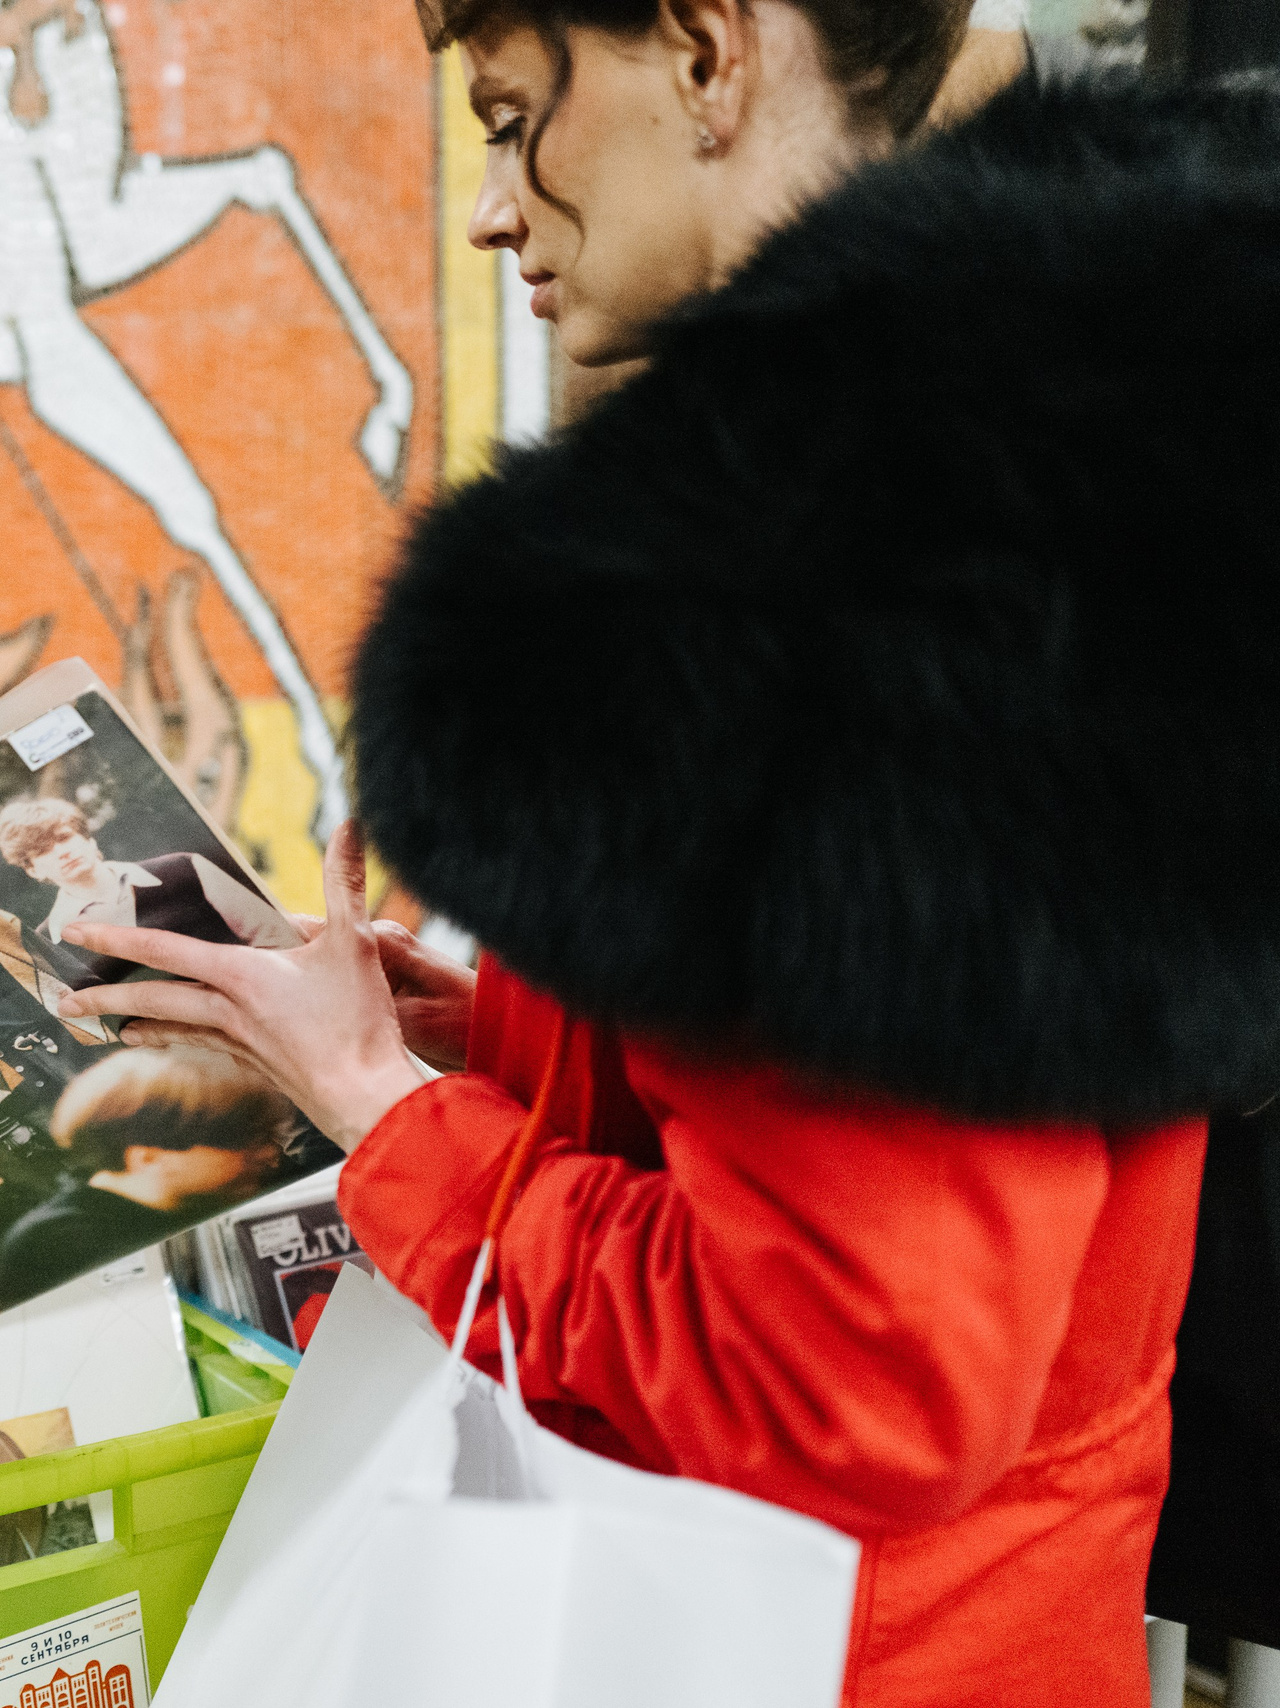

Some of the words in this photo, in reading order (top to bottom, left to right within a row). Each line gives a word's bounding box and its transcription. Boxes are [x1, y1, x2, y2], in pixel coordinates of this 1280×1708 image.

[21, 1634, 90, 1666] СЕНТЯБРЯ
[31, 1642, 38, 1652] 9
[43, 1636, 53, 1647] И
[58, 1630, 72, 1642] 10
